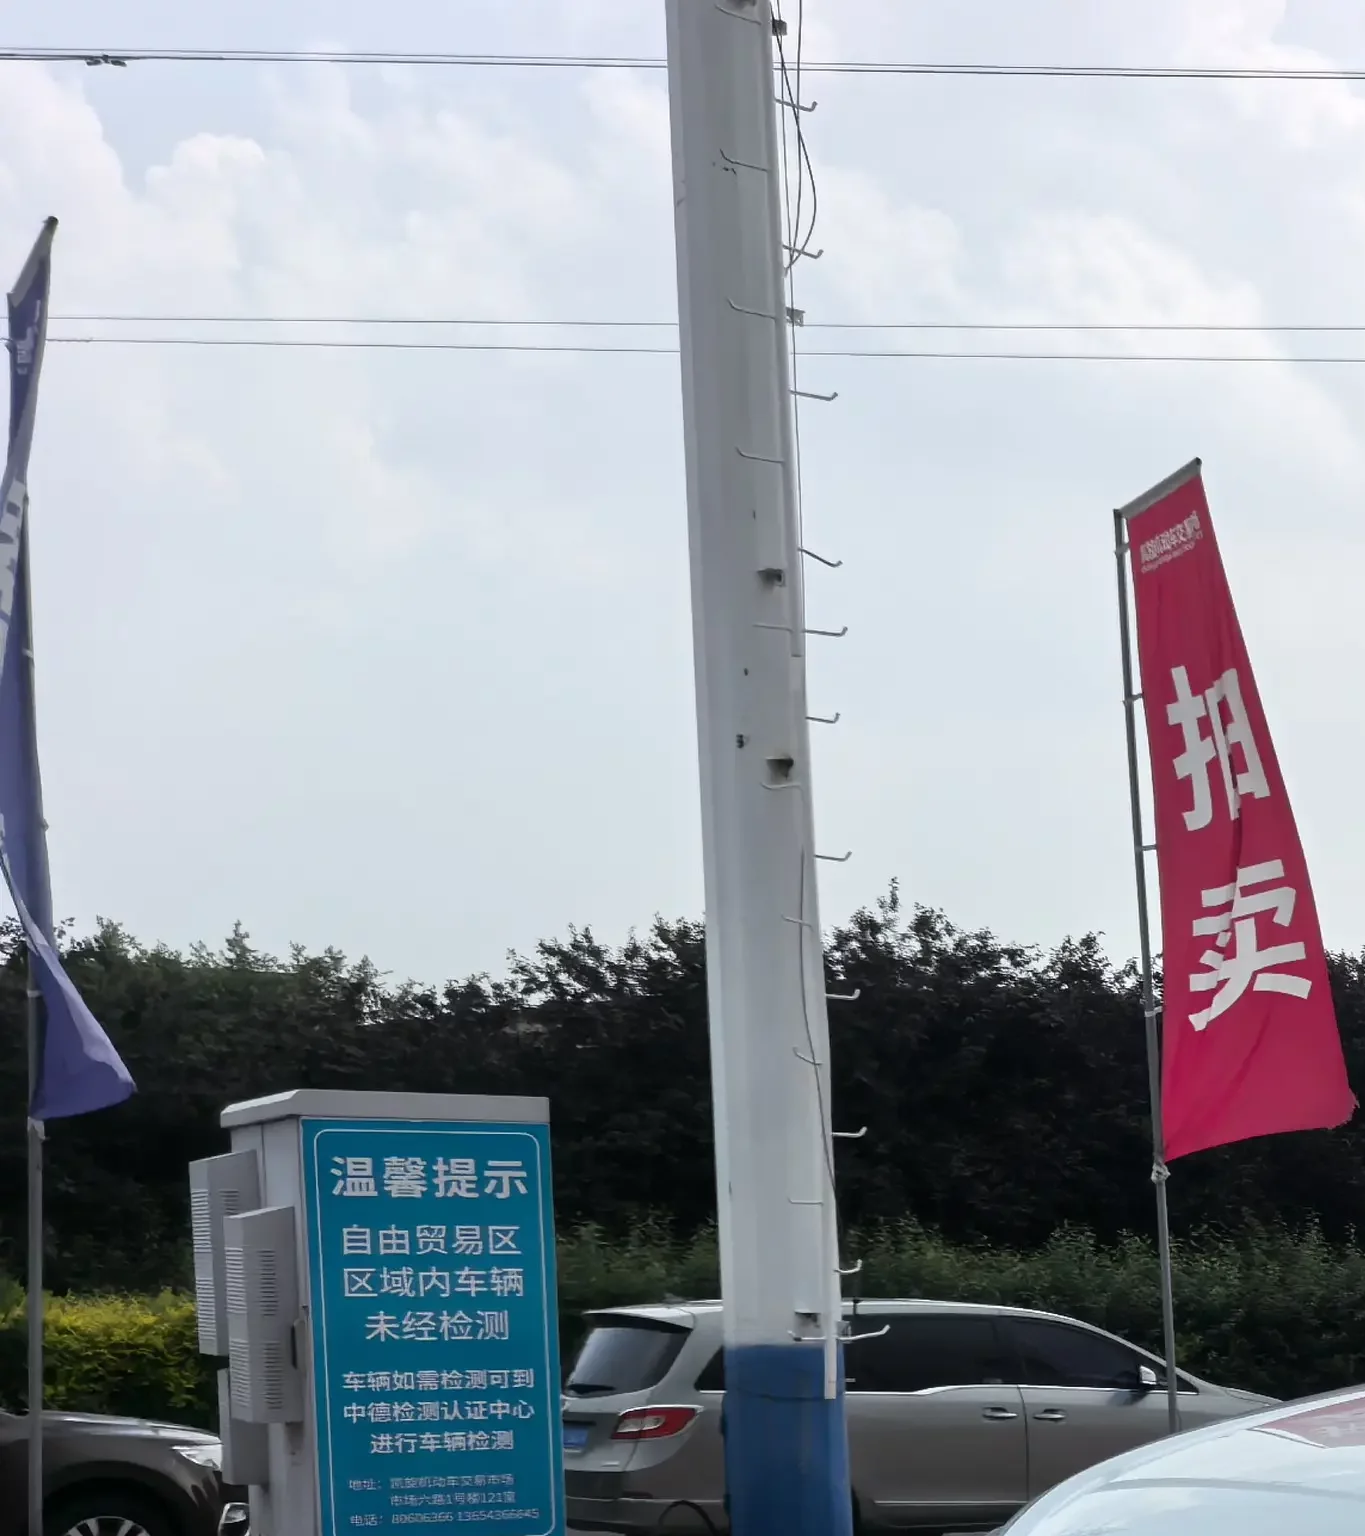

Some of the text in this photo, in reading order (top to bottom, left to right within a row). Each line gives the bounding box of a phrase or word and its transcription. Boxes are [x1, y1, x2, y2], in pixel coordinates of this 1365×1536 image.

[1166, 664, 1313, 1032] 拍卖
[330, 1156, 529, 1200] 温馨提示
[342, 1224, 523, 1256] 自由贸易区
[343, 1266, 524, 1298] 区域内车辆
[364, 1310, 510, 1342] 未经检测
[341, 1367, 536, 1393] 车辆如需检测可到
[343, 1399, 536, 1425] 中德检测认证中心
[370, 1430, 515, 1455] 进行车辆检测
